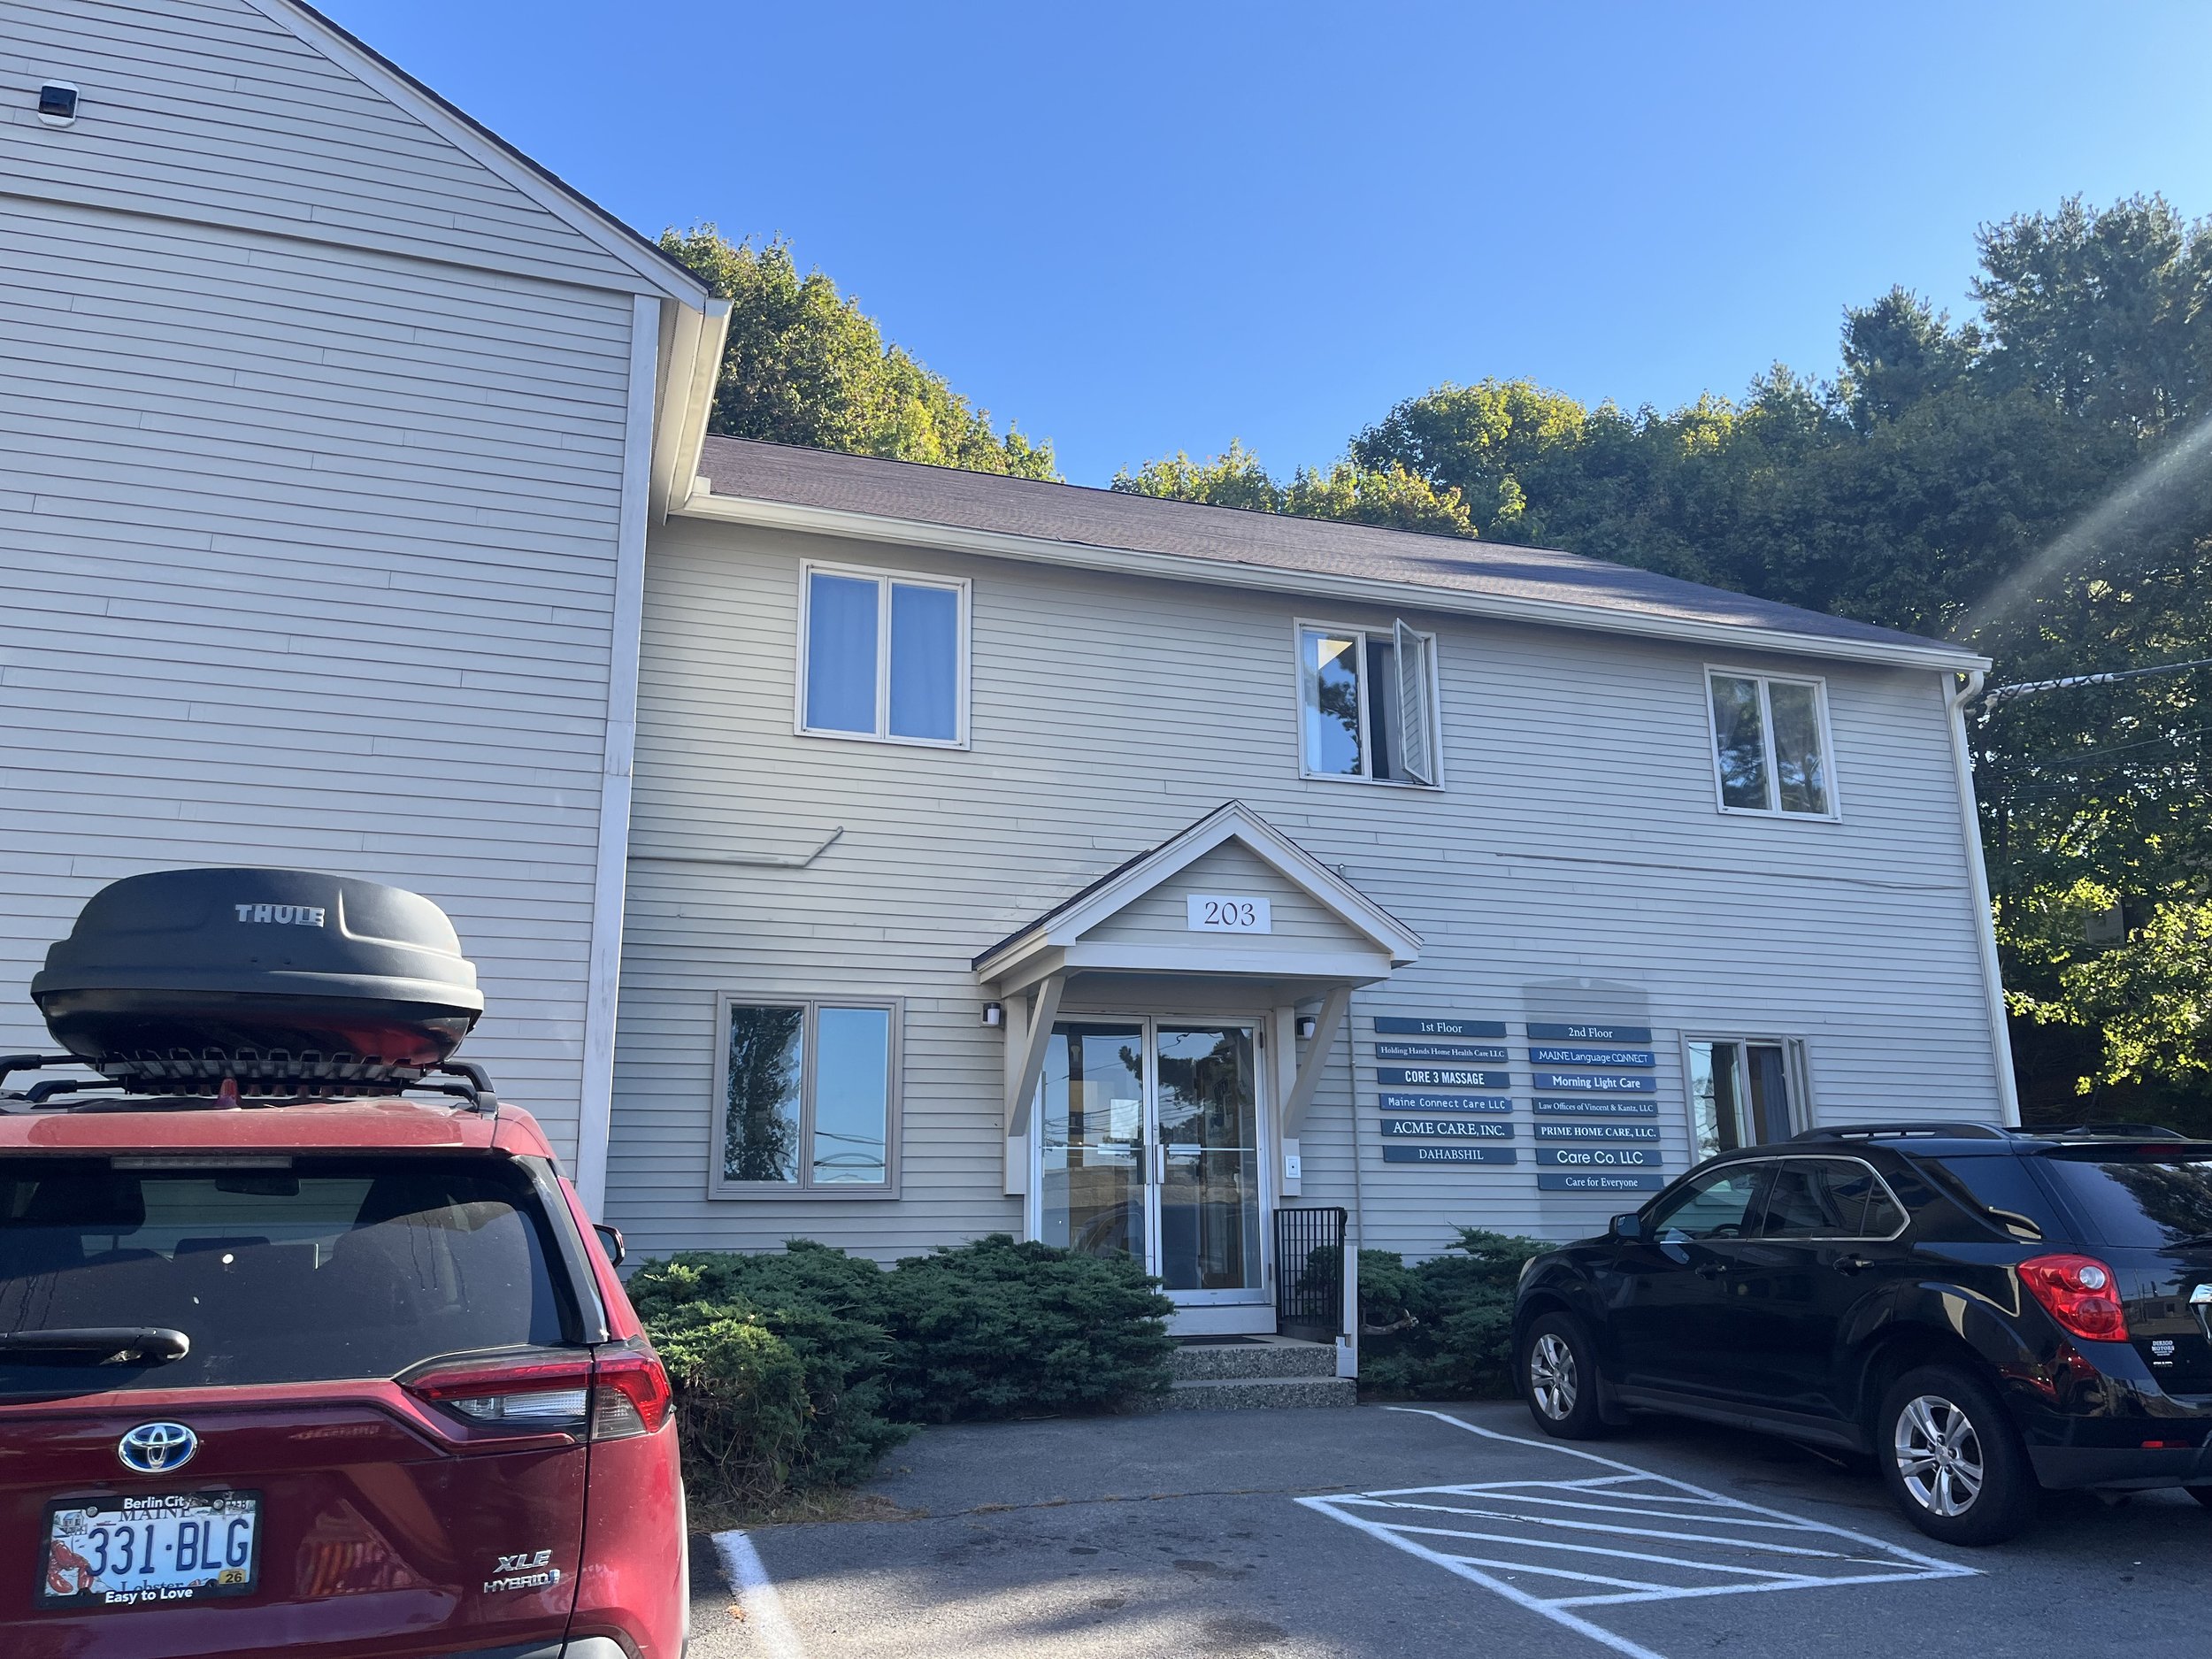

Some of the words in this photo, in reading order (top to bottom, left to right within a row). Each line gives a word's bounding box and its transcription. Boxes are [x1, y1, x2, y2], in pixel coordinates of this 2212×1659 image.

[234, 902, 326, 928] THULE
[1204, 901, 1256, 926] 203
[1420, 1022, 1434, 1032] 1st
[1437, 1022, 1463, 1033] Floor
[1568, 1026, 1586, 1037] 2nd
[1588, 1027, 1613, 1038] Floor
[1380, 1046, 1409, 1056] Holding
[1409, 1047, 1430, 1056] Hands
[1539, 1050, 1570, 1061] MAINE
[1571, 1051, 1610, 1064] Language
[1611, 1053, 1648, 1063] CONNECT
[1405, 1070, 1431, 1083] CORE
[1433, 1071, 1439, 1084] 3
[1441, 1071, 1485, 1085] MASSAGE
[1552, 1075, 1592, 1088] Morning
[1594, 1077, 1617, 1089] Light
[1619, 1078, 1640, 1088] Care
[1388, 1096, 1416, 1107] Maine
[1419, 1098, 1459, 1108] Connect
[1463, 1099, 1486, 1109] Care
[1488, 1100, 1505, 1110] LLC
[1553, 1102, 1575, 1110] Offices
[1393, 1121, 1434, 1134] ACME
[1436, 1122, 1479, 1137] CARE,
[1480, 1125, 1505, 1136] INC.
[1540, 1126, 1571, 1136] PRIME
[1574, 1127, 1603, 1137] HOME
[1605, 1127, 1634, 1138] CARE,
[1635, 1128, 1656, 1138] LLC.
[1418, 1148, 1484, 1161] DAHABSHIL
[1556, 1149, 1591, 1164] Care
[1594, 1150, 1617, 1164] Co.
[1620, 1151, 1644, 1164] LLC
[1565, 1177, 1586, 1187] Care
[1586, 1176, 1599, 1187] for
[1601, 1178, 1638, 1189] Everyone
[124, 1496, 163, 1509] Berlin
[165, 1495, 192, 1509] City
[492, 1549, 553, 1574] XLE
[225, 1572, 242, 1584] 26
[483, 1572, 549, 1594] HYBRID
[104, 1590, 137, 1605] Easy
[141, 1590, 156, 1601] to
[160, 1587, 193, 1600] Love
